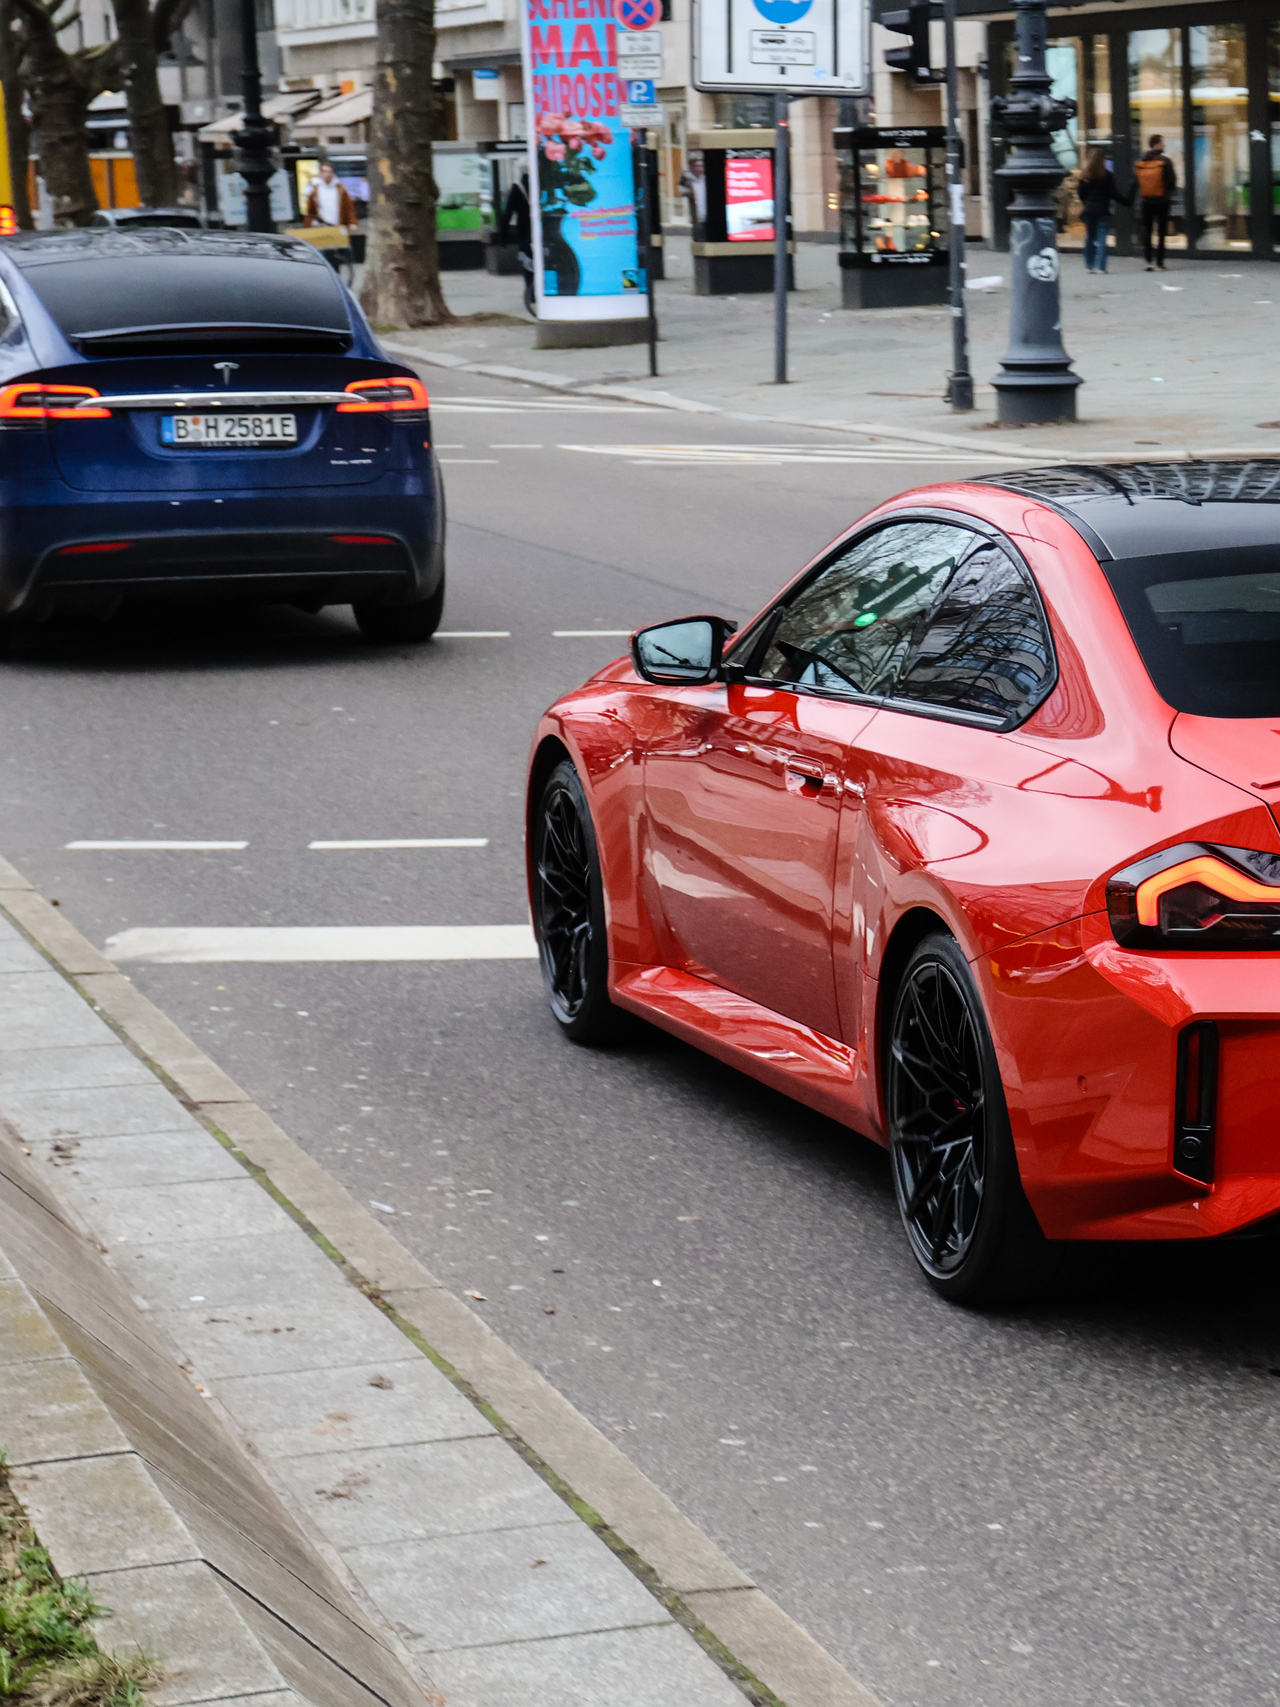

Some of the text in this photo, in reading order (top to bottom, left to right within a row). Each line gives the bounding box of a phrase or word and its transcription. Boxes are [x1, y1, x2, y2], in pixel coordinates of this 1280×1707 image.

[630, 81, 648, 102] P
[176, 416, 295, 439] B H 2581E
